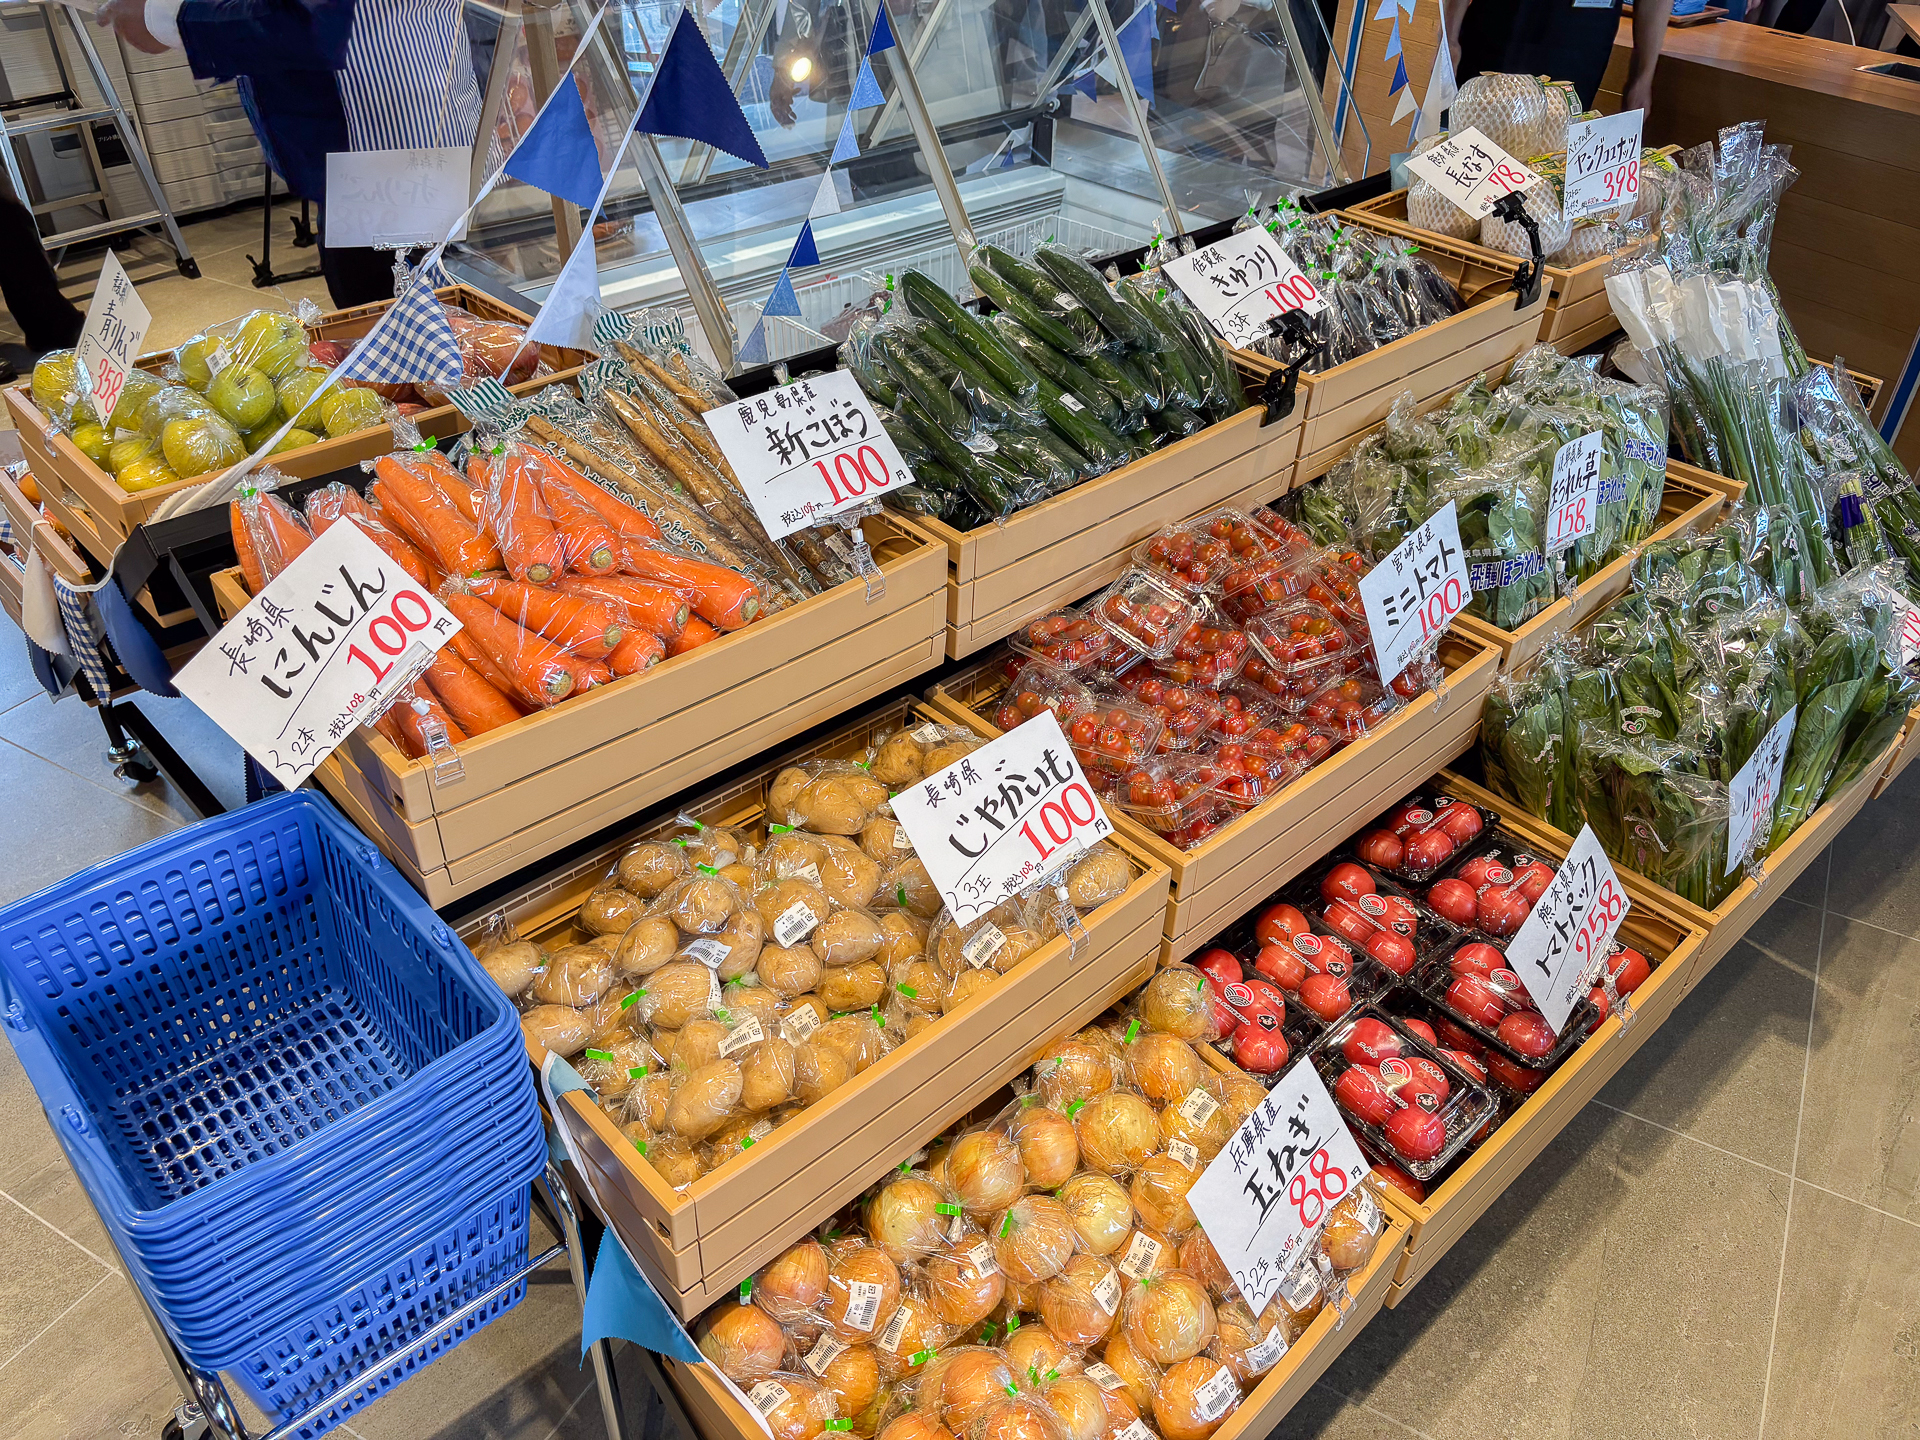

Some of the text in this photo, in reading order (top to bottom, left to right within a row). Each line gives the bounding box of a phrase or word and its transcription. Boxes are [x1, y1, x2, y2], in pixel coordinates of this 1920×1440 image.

[1445, 144, 1494, 188] 長なす
[1574, 134, 1637, 175] ヤングココナッツ
[1191, 247, 1226, 276] 佐賀県
[1210, 244, 1278, 297] きゅうり
[99, 300, 141, 364] 青りんご
[1228, 311, 1249, 332] 3本
[737, 382, 818, 433] 鹿児島県産
[765, 398, 868, 465] 新ごぼう
[1392, 523, 1435, 576] 宮崎県産
[1383, 538, 1456, 627] ミニトマト
[219, 597, 294, 676] 長崎県
[261, 564, 387, 699] にんじん
[291, 727, 316, 756] 2本
[924, 759, 982, 808] 長崎県
[963, 874, 992, 899] 3玉
[1536, 858, 1581, 929] 熊本県産
[1535, 855, 1597, 978] トマトパック
[1229, 1098, 1282, 1174] 兵庫県産
[1242, 1094, 1321, 1225] 玉ねぎ
[1250, 1256, 1270, 1285] 2玉
